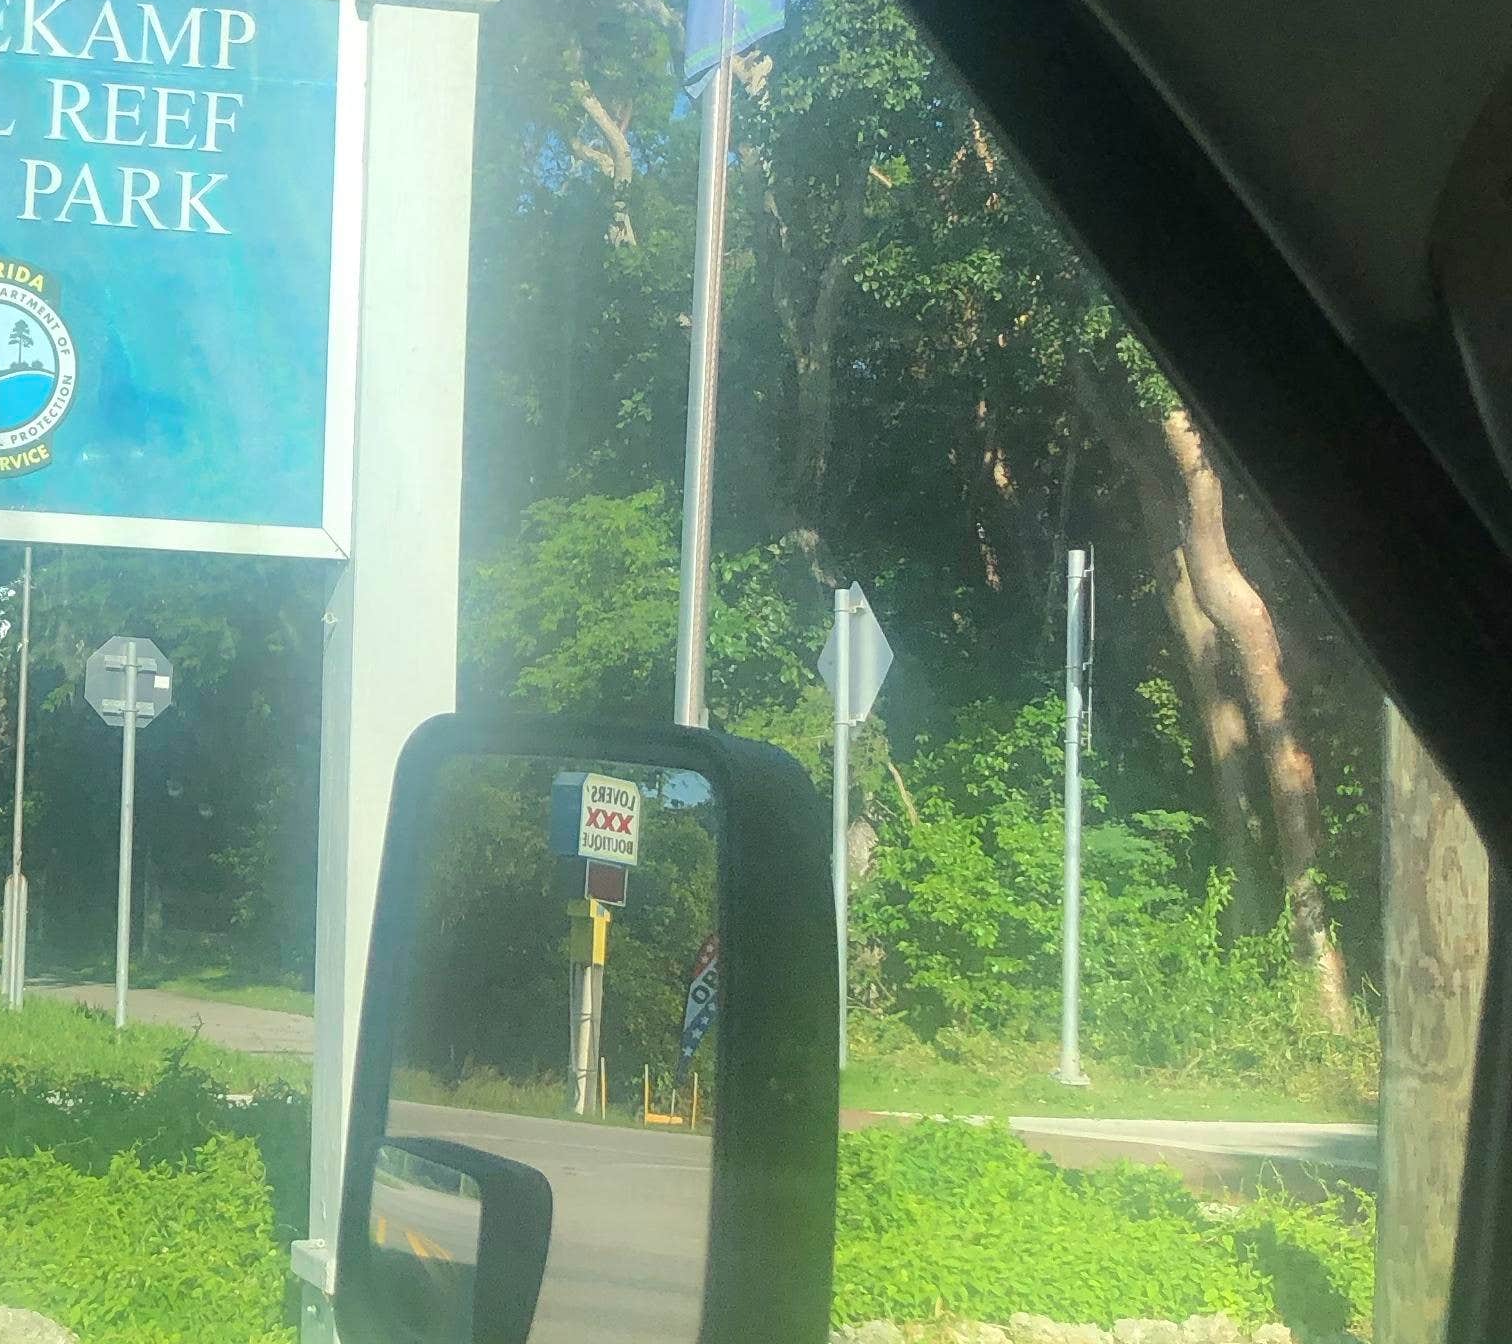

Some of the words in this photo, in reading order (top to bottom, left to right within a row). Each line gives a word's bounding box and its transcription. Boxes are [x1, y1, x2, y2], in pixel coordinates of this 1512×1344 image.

[43, 78, 244, 152] REEF
[15, 158, 232, 236] PARK
[57, 336, 71, 356] OF
[10, 374, 73, 445] PROTECTION
